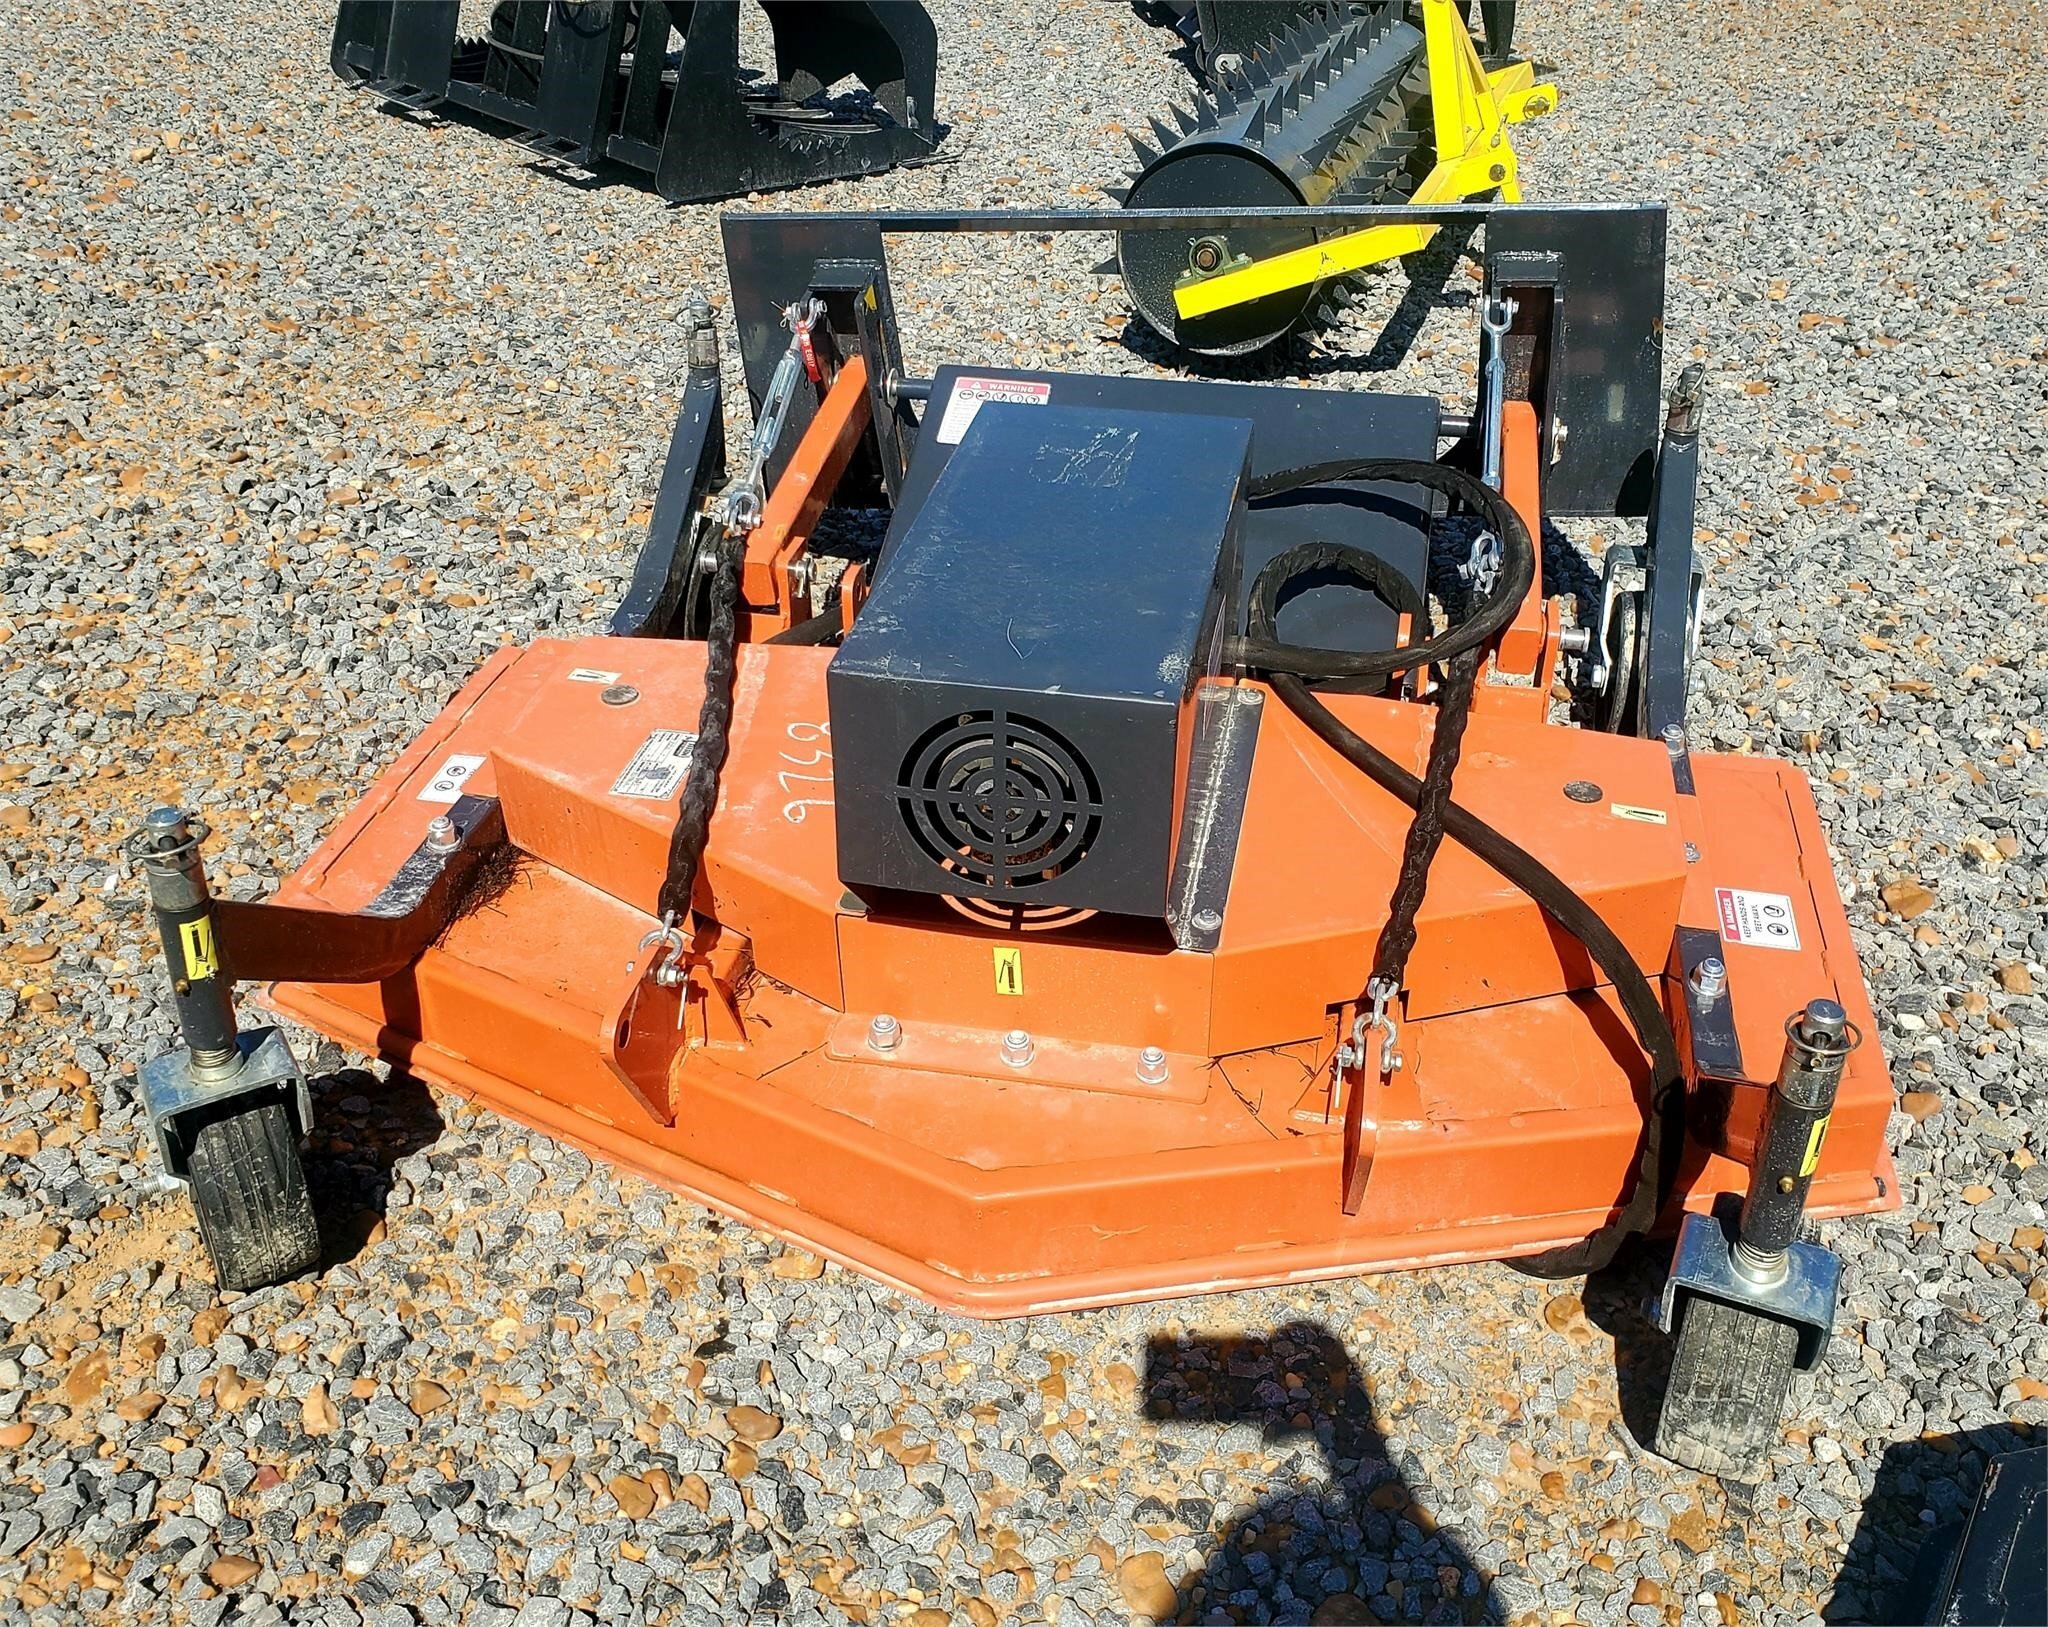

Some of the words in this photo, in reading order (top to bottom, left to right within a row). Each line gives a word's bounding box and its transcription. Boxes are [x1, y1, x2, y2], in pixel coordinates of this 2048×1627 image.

[989, 383, 1034, 393] WARNING
[1737, 895, 1745, 907] AND
[1722, 897, 1735, 924] DANGER
[1739, 907, 1749, 925] HANDS
[1742, 925, 1751, 938] KEEP
